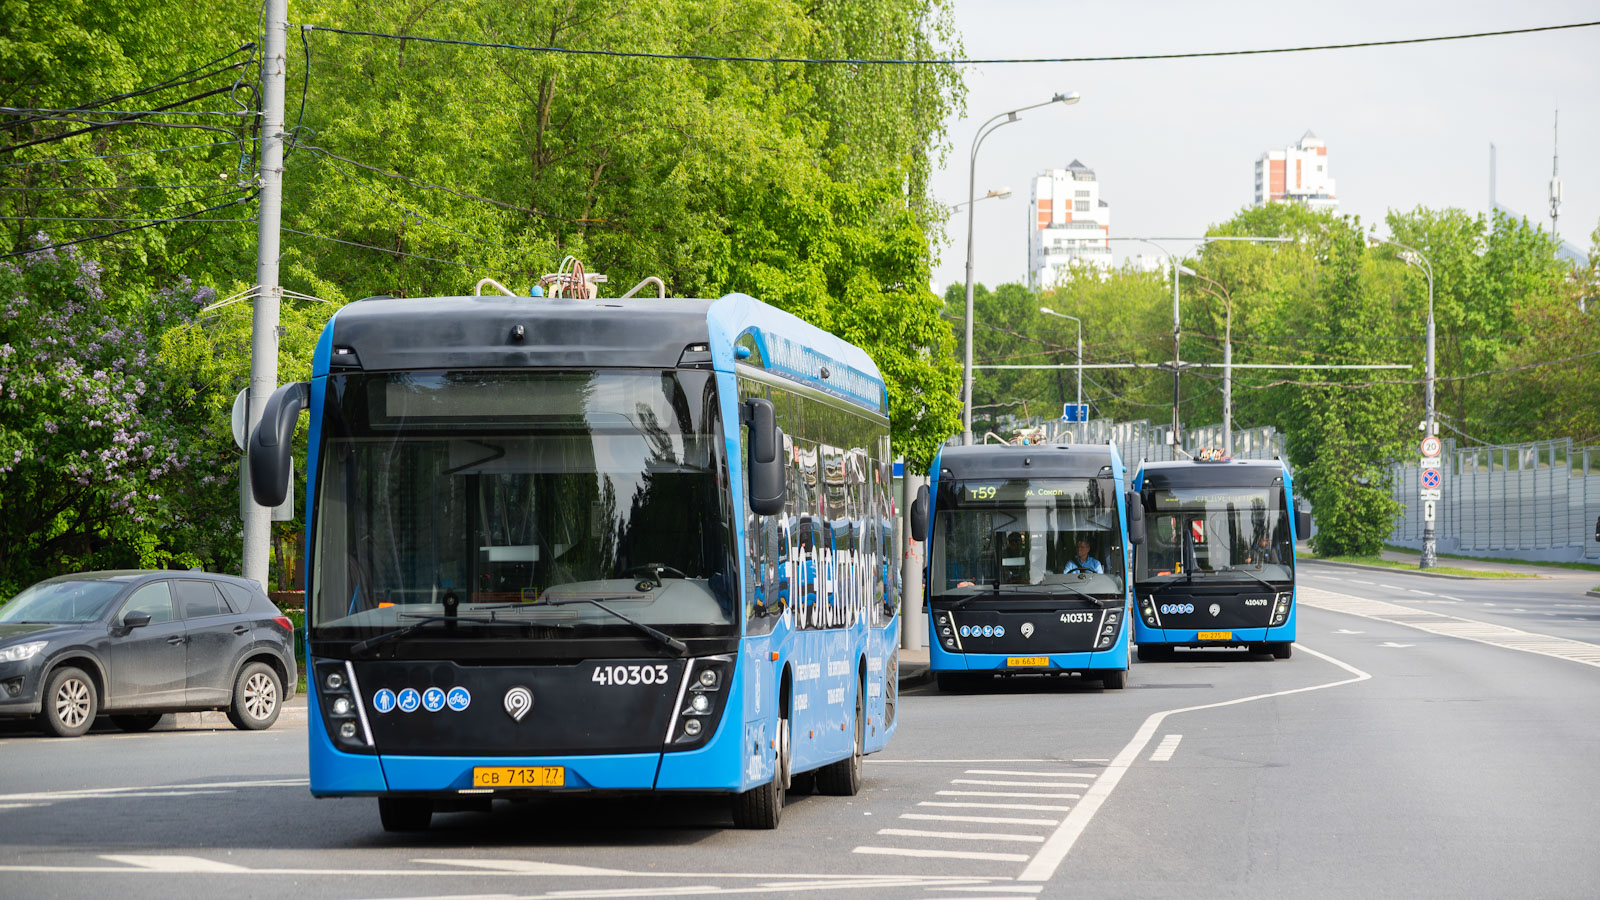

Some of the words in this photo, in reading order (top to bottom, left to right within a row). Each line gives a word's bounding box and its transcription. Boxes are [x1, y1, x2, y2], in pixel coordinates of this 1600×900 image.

[1038, 488, 1063, 496] Сокол
[782, 511, 807, 630] Это
[1060, 612, 1093, 623] 410313
[591, 665, 669, 685] 410303
[481, 772, 500, 784] СВ
[507, 770, 534, 784] 713
[544, 768, 558, 780] 77
